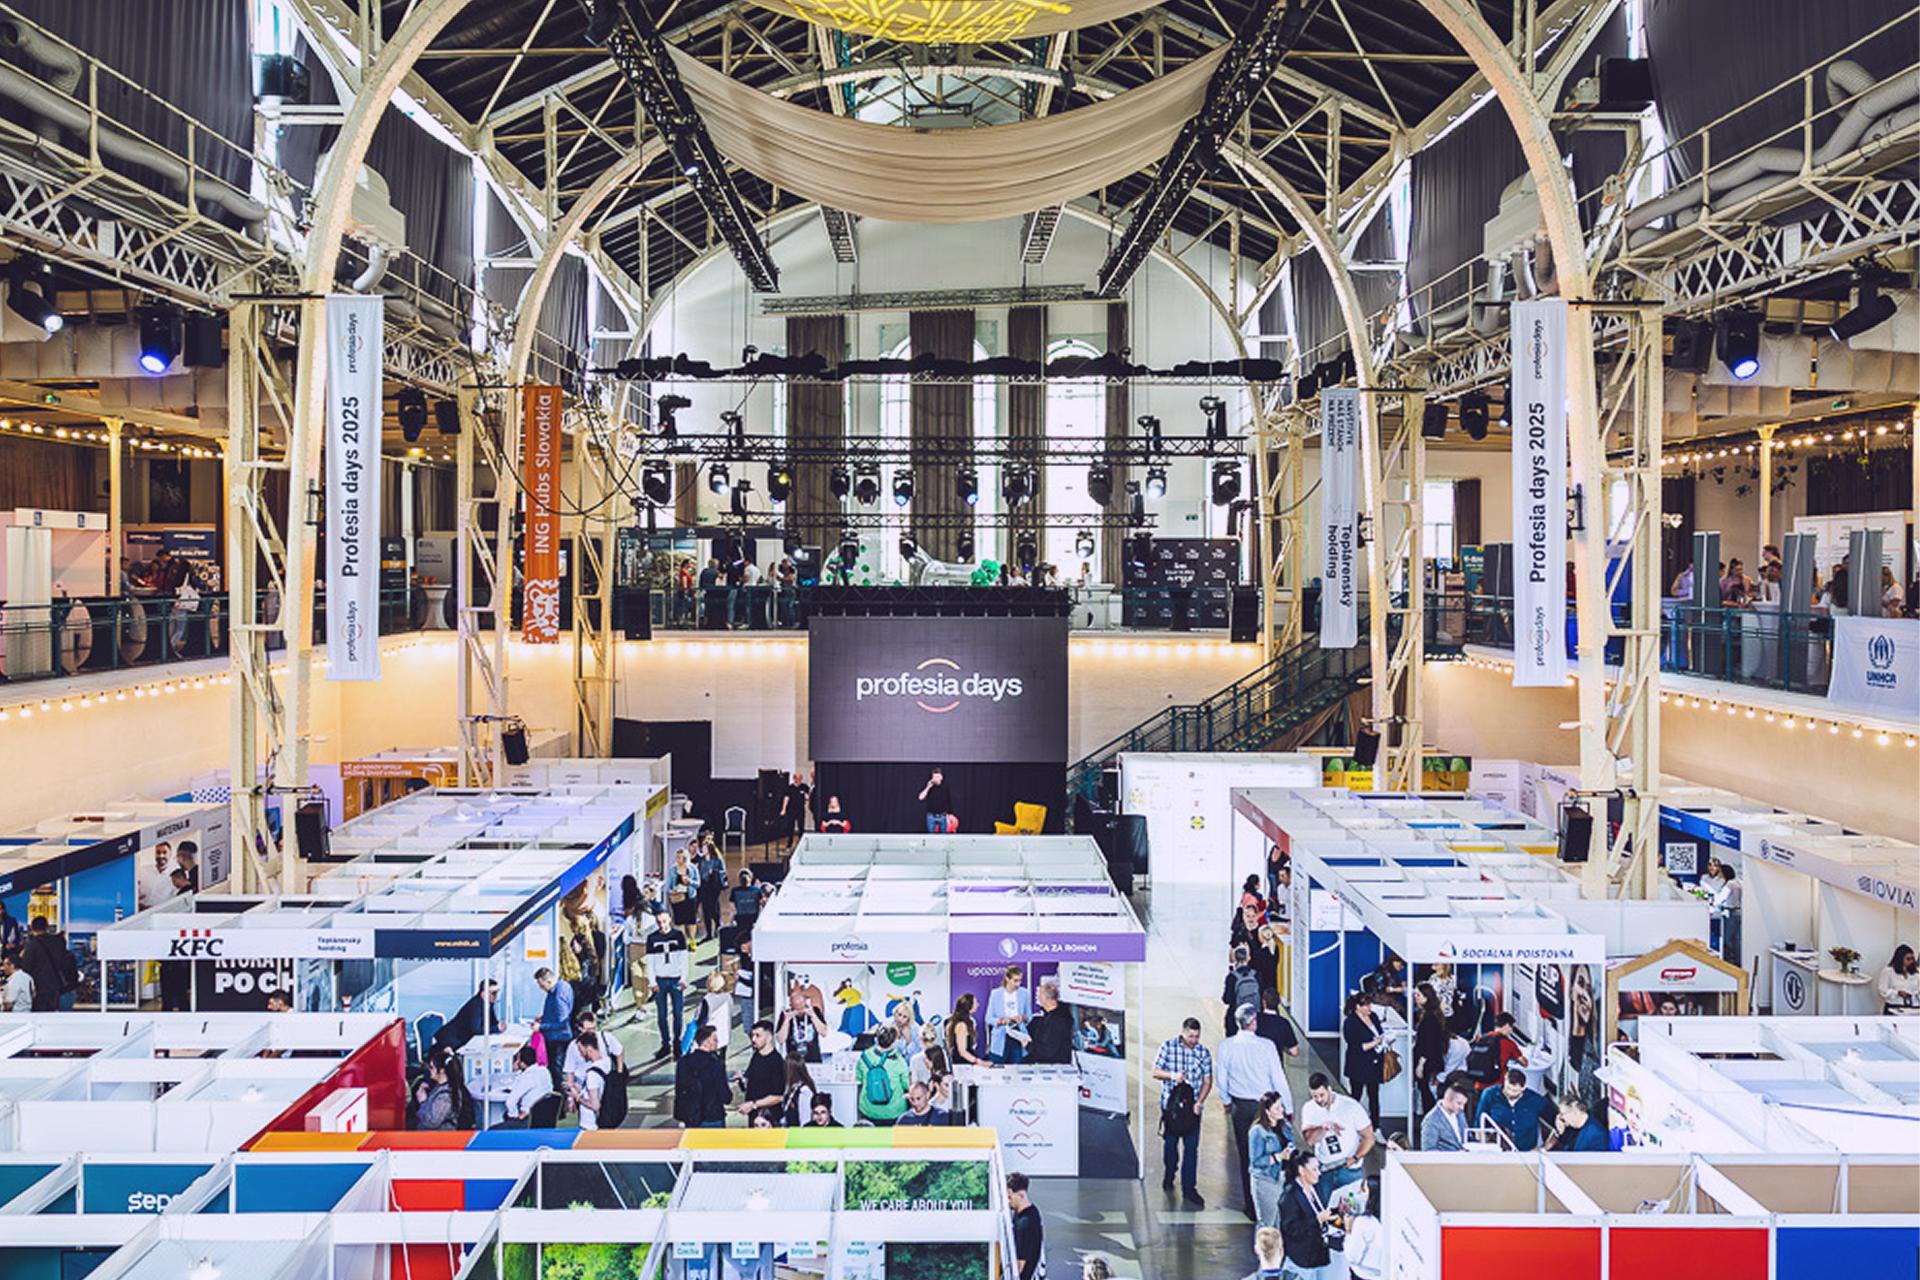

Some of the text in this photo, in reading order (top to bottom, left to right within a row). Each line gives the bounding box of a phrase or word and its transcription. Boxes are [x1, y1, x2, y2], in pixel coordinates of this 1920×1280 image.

[348, 313, 358, 373] profesia days
[1533, 319, 1544, 379] profesia days
[341, 396, 363, 577] Profesia days 2025
[535, 394, 551, 554] ING Hubs Slovakia
[1529, 402, 1550, 583] Profesia days 2025
[1326, 524, 1339, 579] holding
[348, 601, 358, 662] profesia days
[1534, 606, 1546, 666] profesia days
[856, 672, 1023, 702] profesia days
[1866, 671, 1897, 684] UNHCR
[168, 938, 224, 957] KFC
[831, 942, 868, 952] profesia
[1021, 942, 1050, 953] PRÁCA
[1051, 944, 1063, 953] ZA
[215, 971, 255, 994] PO
[860, 1199, 973, 1211] WE CARE ABOUT YOU
